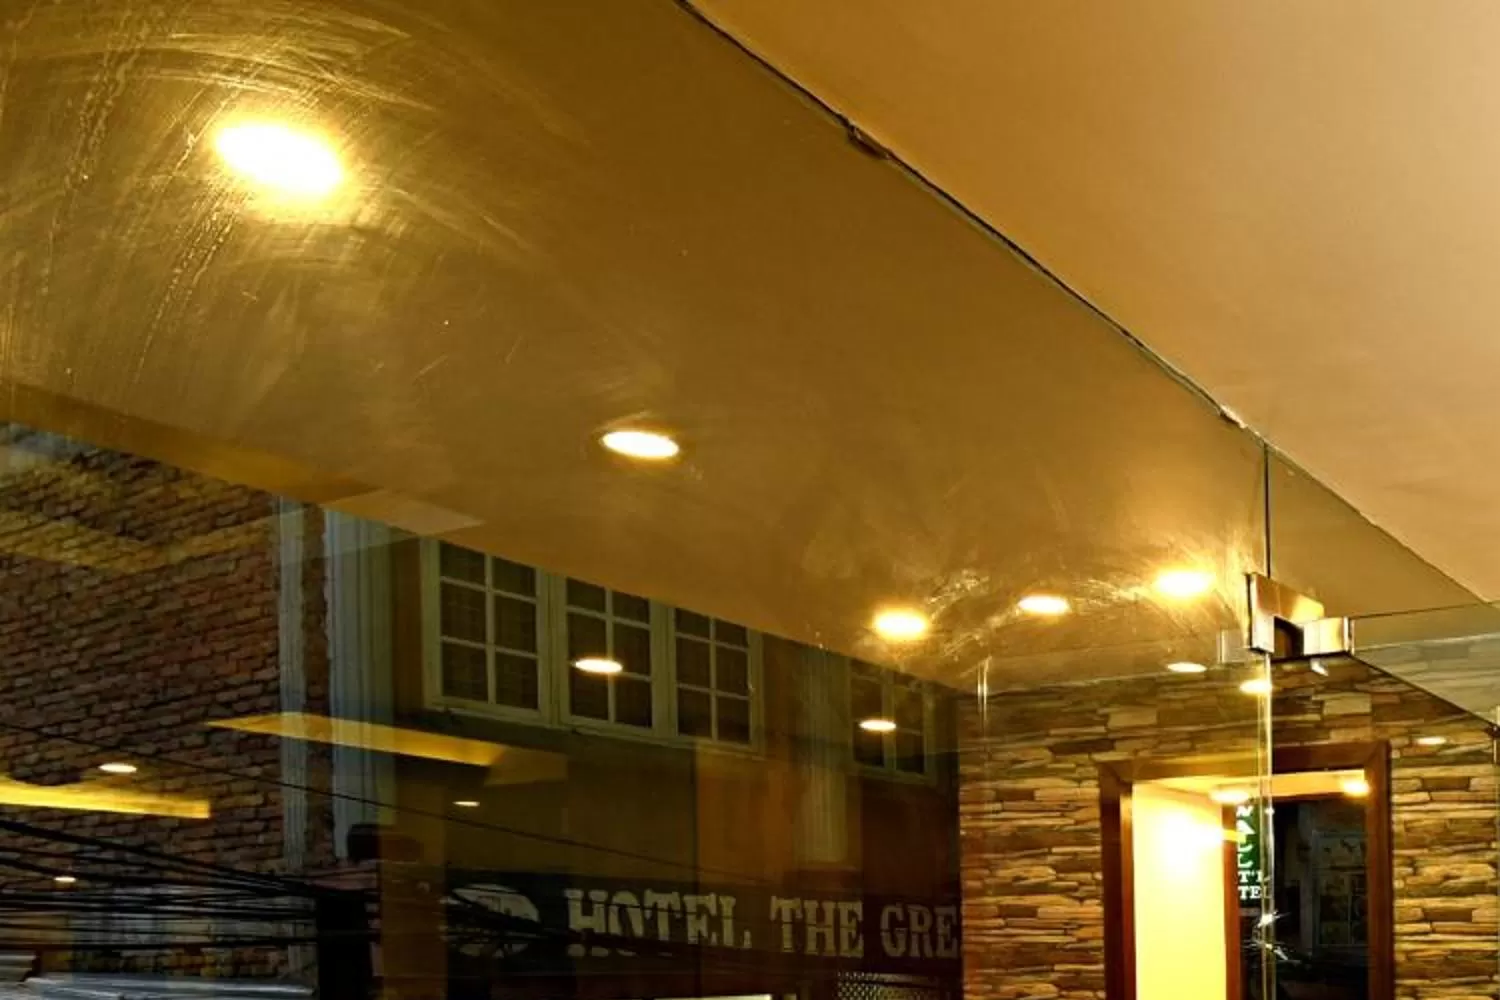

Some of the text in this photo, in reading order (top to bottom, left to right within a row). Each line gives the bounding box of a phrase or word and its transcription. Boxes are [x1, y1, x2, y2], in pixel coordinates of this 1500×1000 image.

[1237, 885, 1272, 900] TEL
[562, 887, 752, 957] HOTEL
[769, 895, 865, 957] THE
